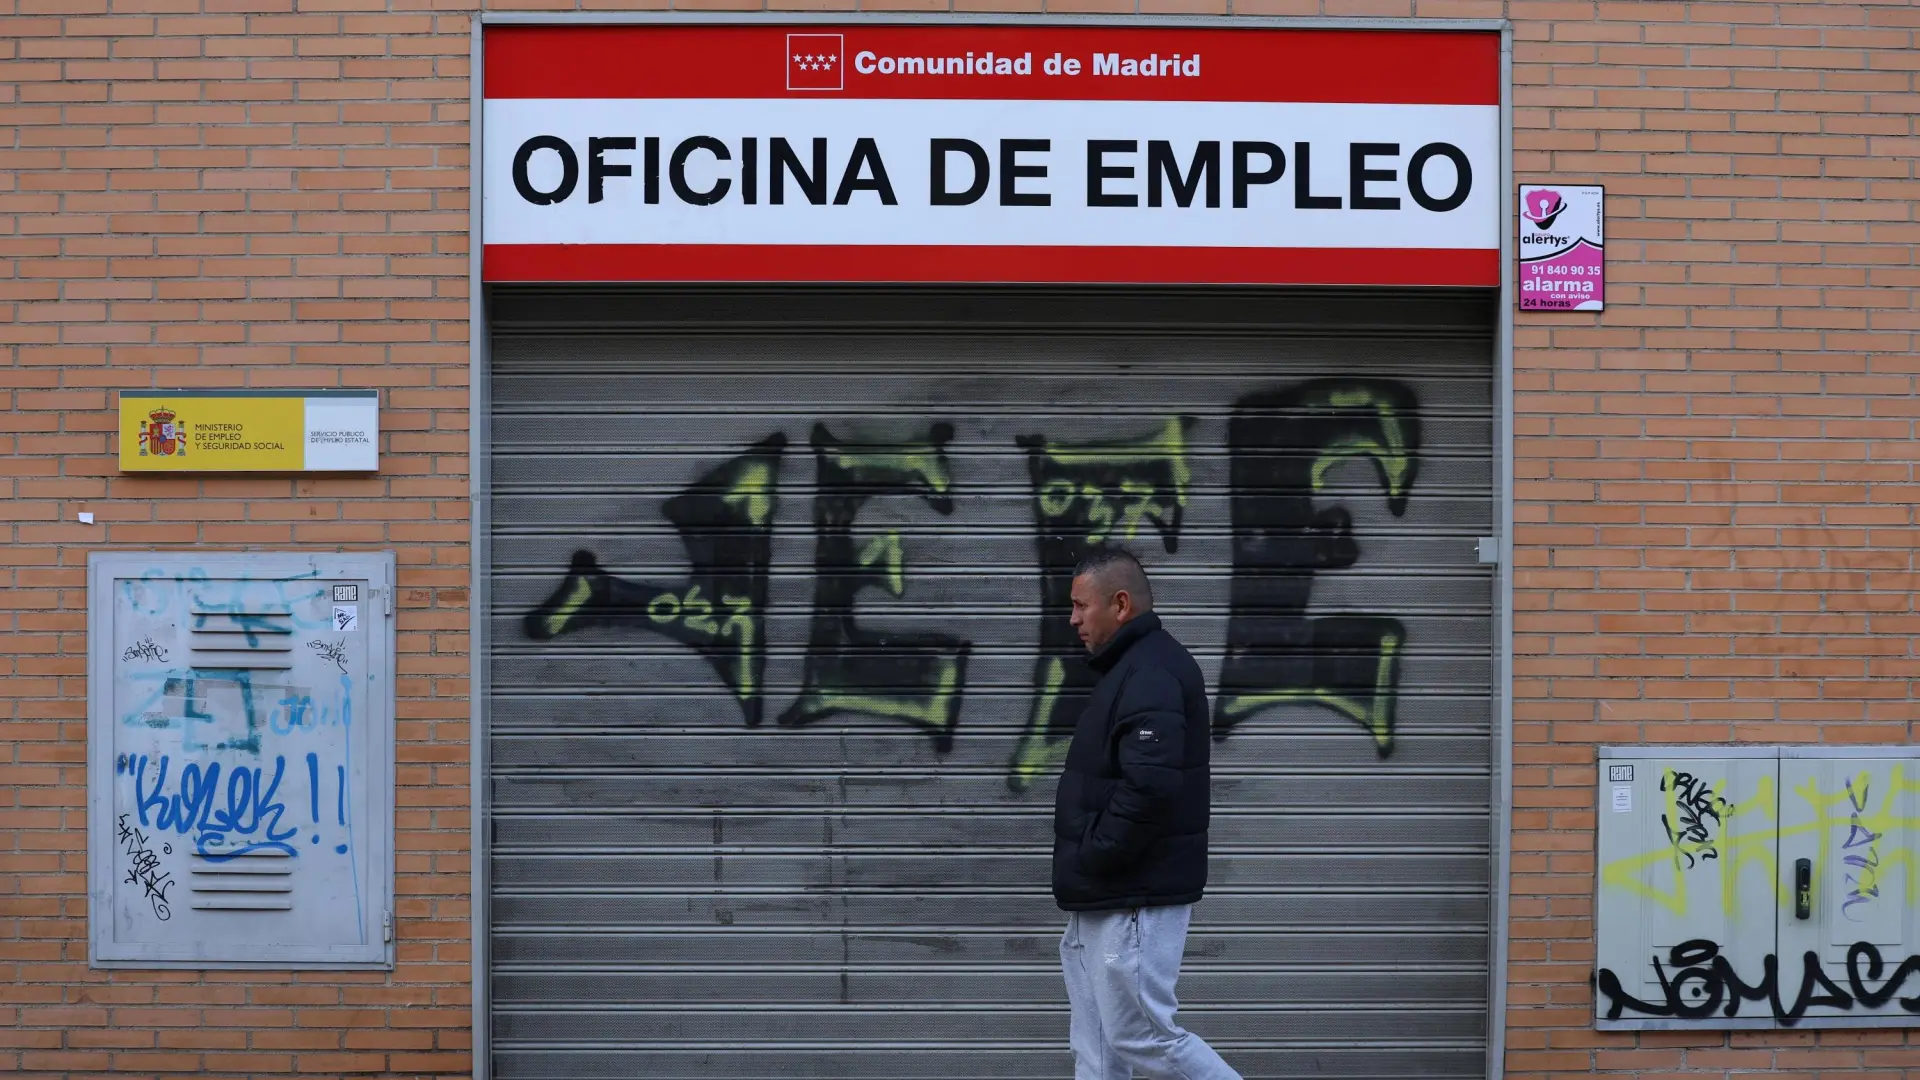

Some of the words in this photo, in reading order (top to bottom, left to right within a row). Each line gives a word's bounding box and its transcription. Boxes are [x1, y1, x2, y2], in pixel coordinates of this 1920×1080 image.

[854, 51, 1032, 75] Comunidad
[1043, 53, 1081, 75] de
[1092, 53, 1200, 77] Madrid
[512, 135, 898, 206] OFICINA
[929, 138, 1051, 207] DE
[1086, 139, 1472, 212] EMPLEO
[1522, 232, 1568, 247] alertys
[1532, 265, 1544, 274] 91
[1547, 265, 1568, 275] 840
[1571, 266, 1584, 275] 90
[1587, 266, 1601, 275] 35
[1522, 277, 1594, 292] alarma
[1523, 298, 1537, 307] 24
[1540, 299, 1571, 307] horas
[195, 423, 243, 431] MINISTERIO
